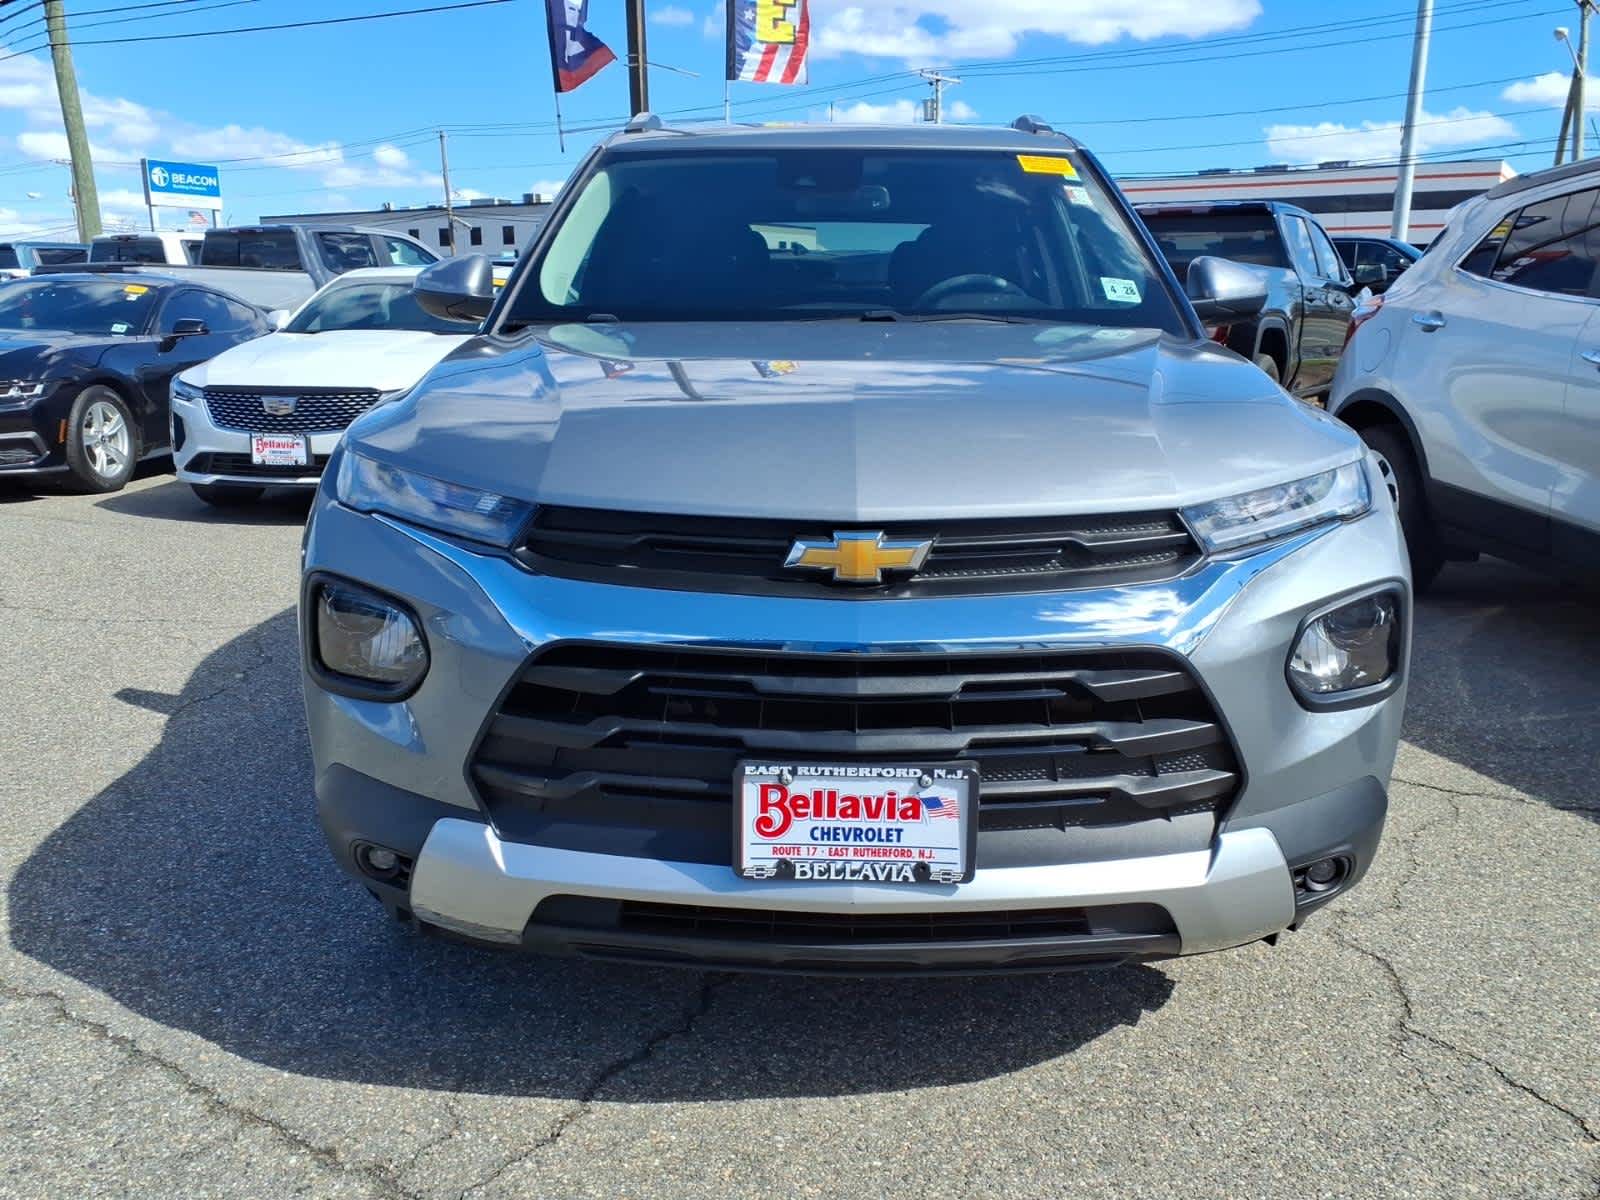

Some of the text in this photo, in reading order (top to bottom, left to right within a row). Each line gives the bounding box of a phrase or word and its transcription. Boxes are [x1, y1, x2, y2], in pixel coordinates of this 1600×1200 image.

[171, 173, 218, 188] BEACON
[255, 438, 296, 454] Bellavia
[744, 766, 793, 777] EAST
[933, 769, 969, 779] N.J.
[754, 783, 922, 838] Bellavia
[810, 826, 904, 843] CHEVROLET
[772, 846, 801, 856] ROUTE
[806, 847, 818, 856] 17
[828, 848, 850, 857] EAST
[918, 848, 936, 859] N.J.
[795, 862, 916, 882] BELLAVIA
